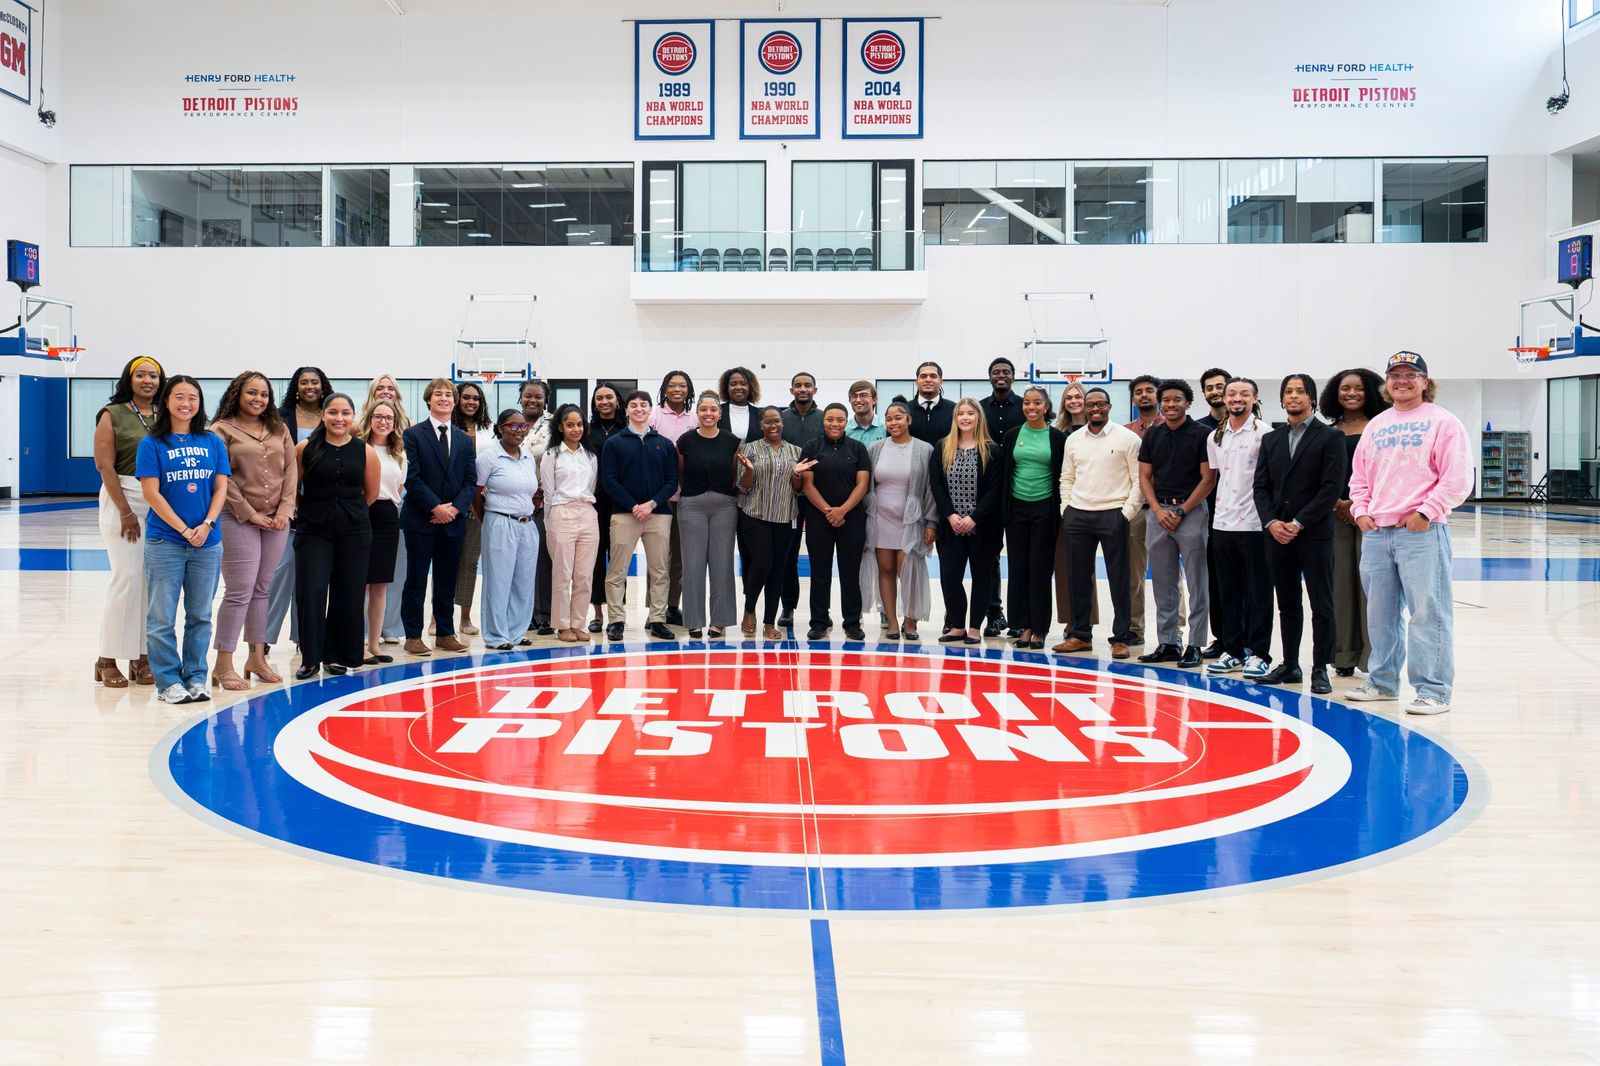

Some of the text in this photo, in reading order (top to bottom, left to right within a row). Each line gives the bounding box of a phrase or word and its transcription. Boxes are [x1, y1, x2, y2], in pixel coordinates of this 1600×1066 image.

[0, 32, 26, 76] GM
[661, 46, 689, 54] DETROIT
[766, 45, 794, 53] DETROIT
[870, 44, 896, 52] DETROIT
[1295, 64, 1334, 72] HENRY
[1338, 64, 1366, 72] FORD
[254, 74, 296, 82] HEALTH
[659, 83, 690, 97] 1989
[764, 82, 796, 96] 1990
[865, 81, 901, 96] 2004
[1292, 87, 1416, 102] DETROIT PISTONS
[182, 97, 298, 111] DETROIT PISTONS
[646, 101, 703, 111] NBA WORLD
[751, 101, 809, 110] NBA WORLD
[854, 100, 912, 110] NBA WORLD
[646, 115, 703, 126] CHAMPIONS
[752, 115, 808, 126] CHAMPIONS
[854, 114, 911, 124] CHAMPIONS
[1372, 420, 1431, 440] LOONEY
[1375, 433, 1423, 450] TUNES
[166, 446, 209, 460] DETROIT
[488, 686, 1117, 722] DETROIT
[435, 717, 1189, 763] PISTONS
